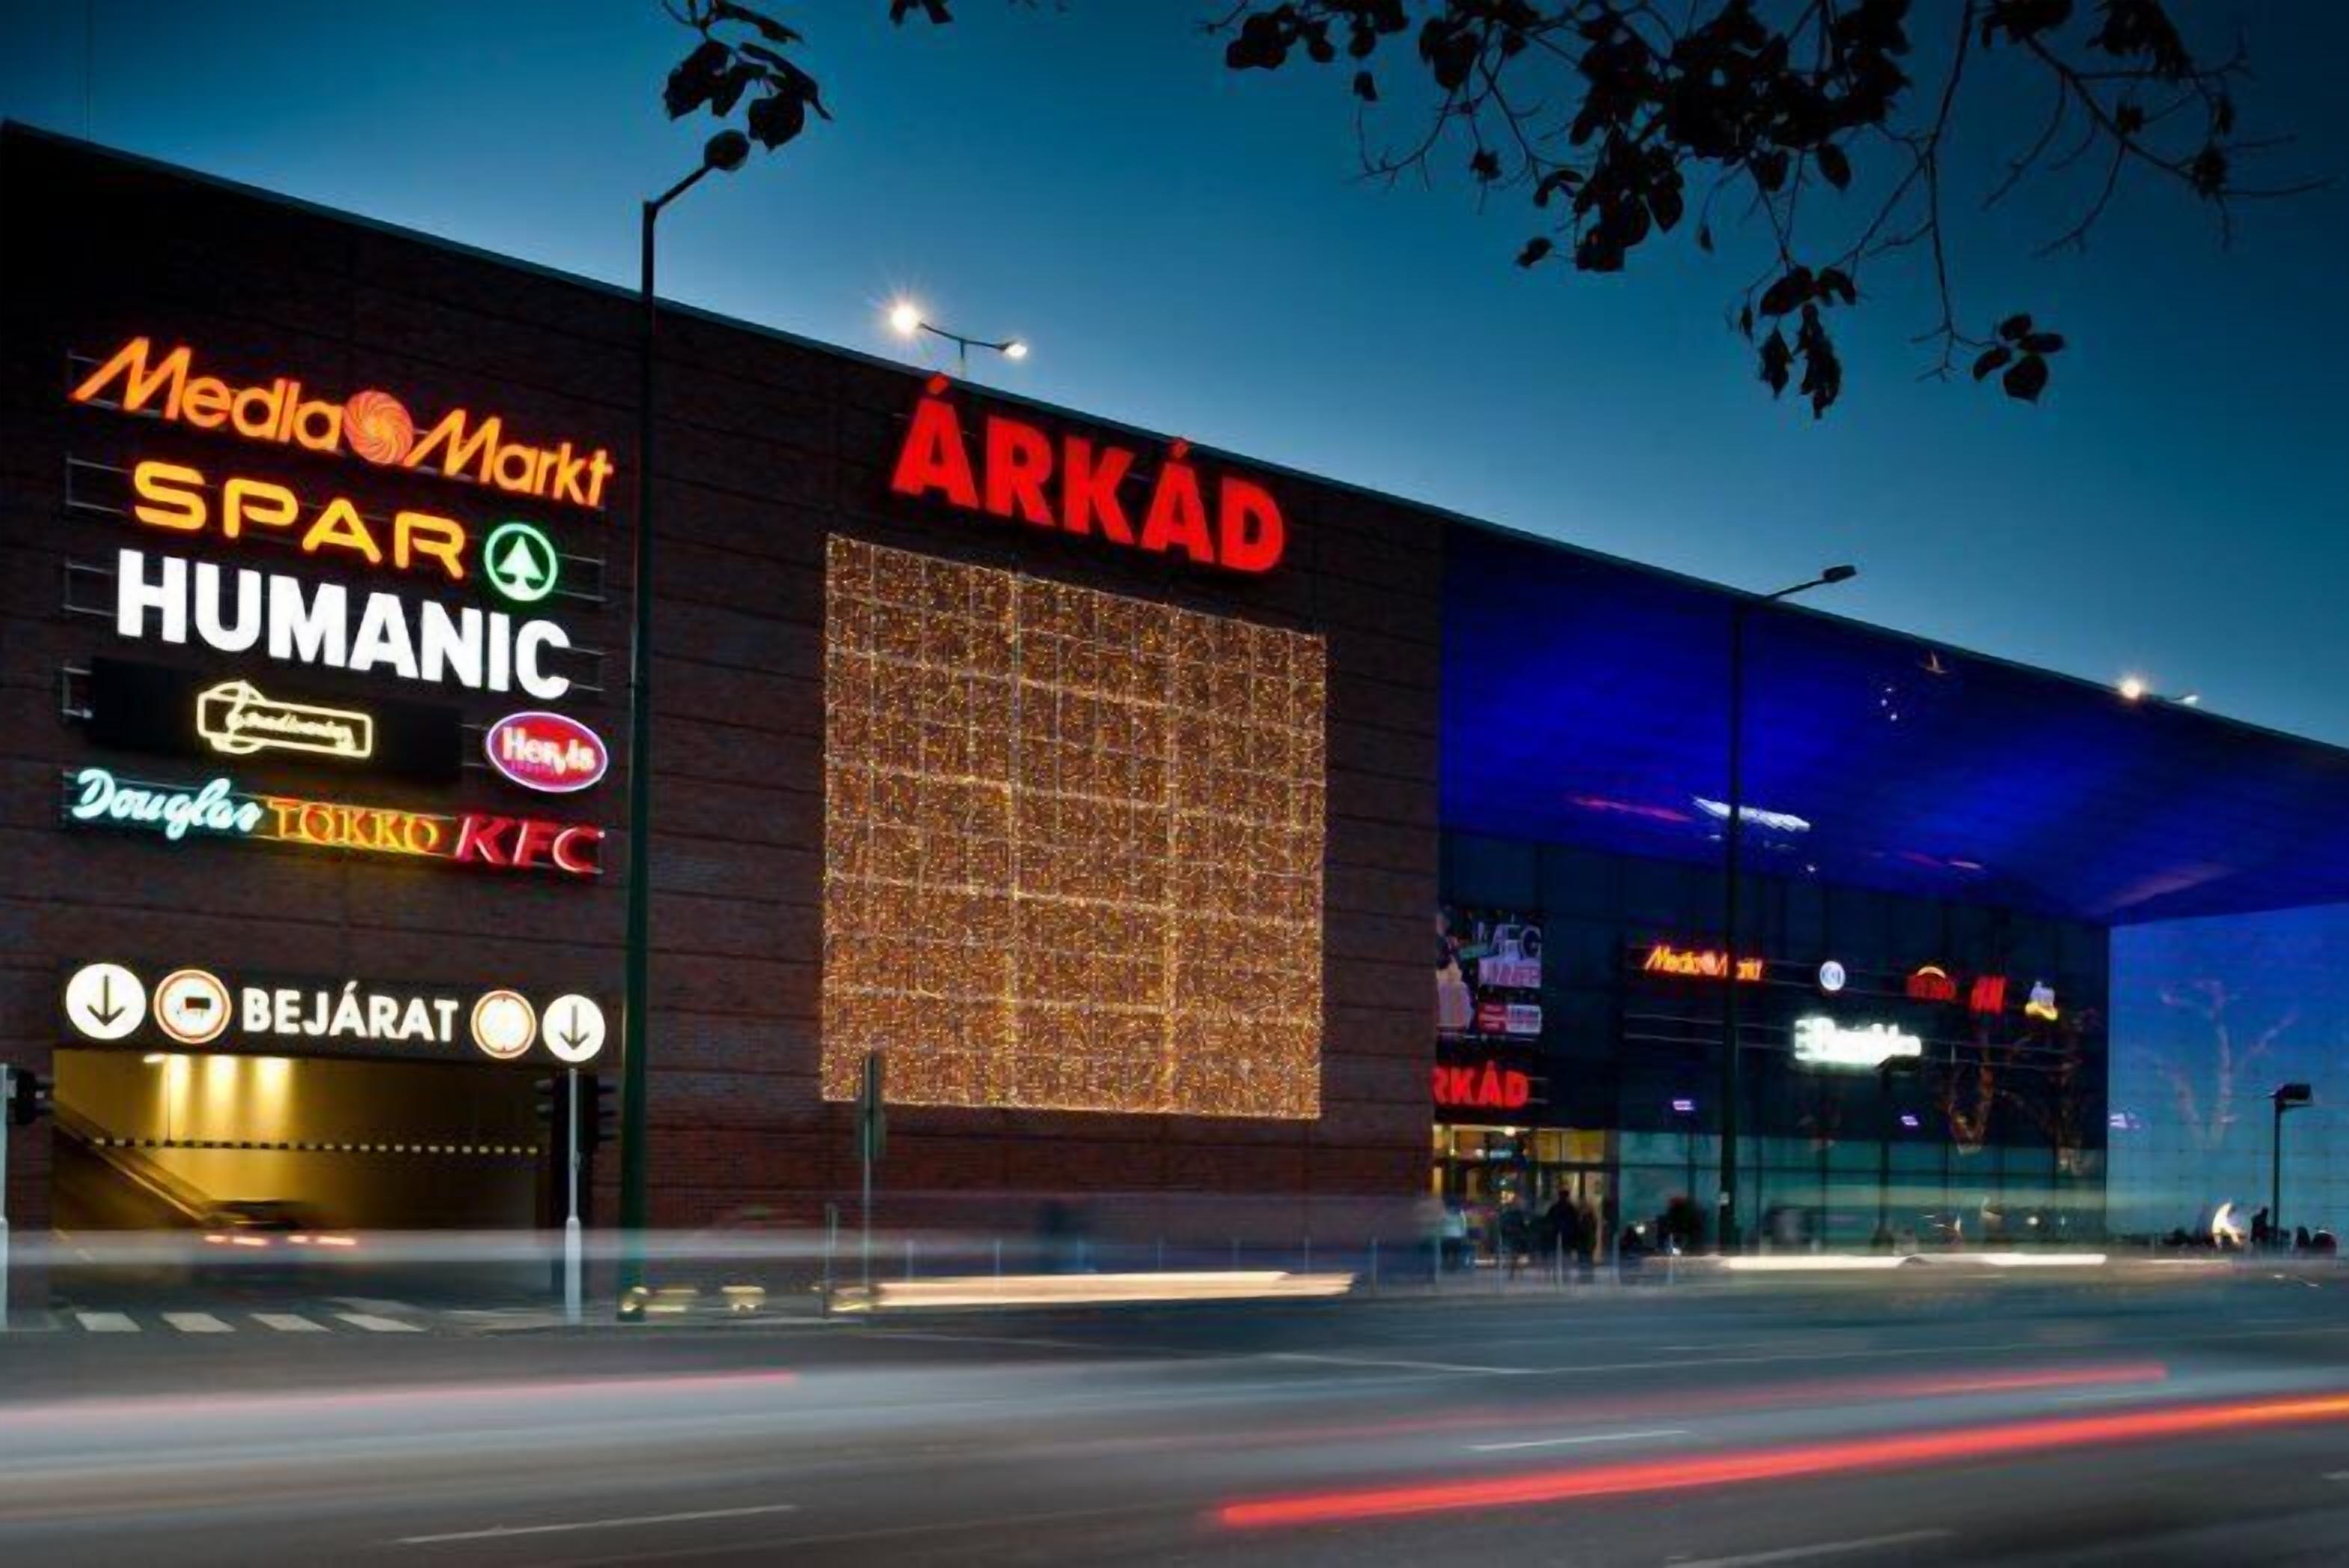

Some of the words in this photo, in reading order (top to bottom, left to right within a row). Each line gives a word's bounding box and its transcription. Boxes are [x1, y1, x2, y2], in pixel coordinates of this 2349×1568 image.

[134, 461, 465, 579] SPAR
[892, 371, 1284, 573] ÁRKÁD
[117, 548, 572, 700] HUMANIC
[456, 815, 604, 872] KFC
[242, 981, 459, 1041] BEJÁRAT
